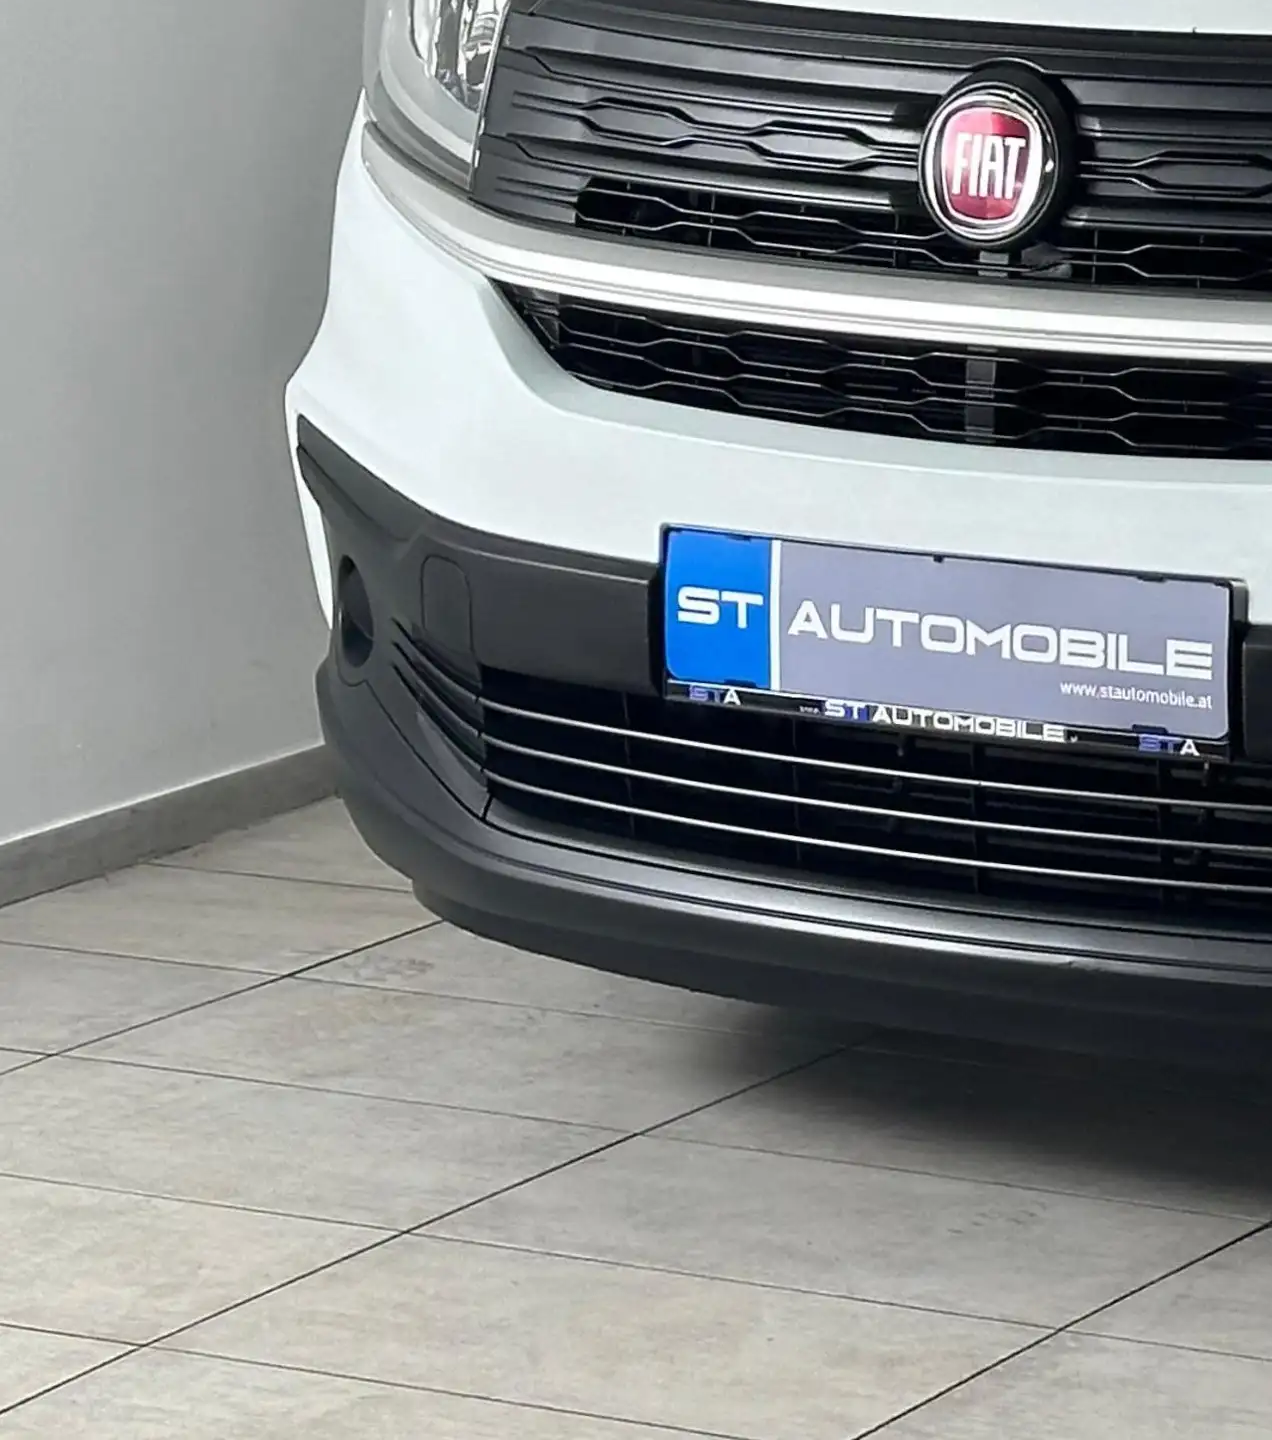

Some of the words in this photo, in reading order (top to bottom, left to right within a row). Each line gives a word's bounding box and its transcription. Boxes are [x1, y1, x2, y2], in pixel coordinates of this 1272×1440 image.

[951, 131, 1026, 200] FIAT
[677, 586, 763, 629] ST
[787, 599, 1213, 681] AUTOMOBILE
[1059, 679, 1213, 710] www.stautomobile.at
[871, 703, 1067, 744] AUTOMOBILE
